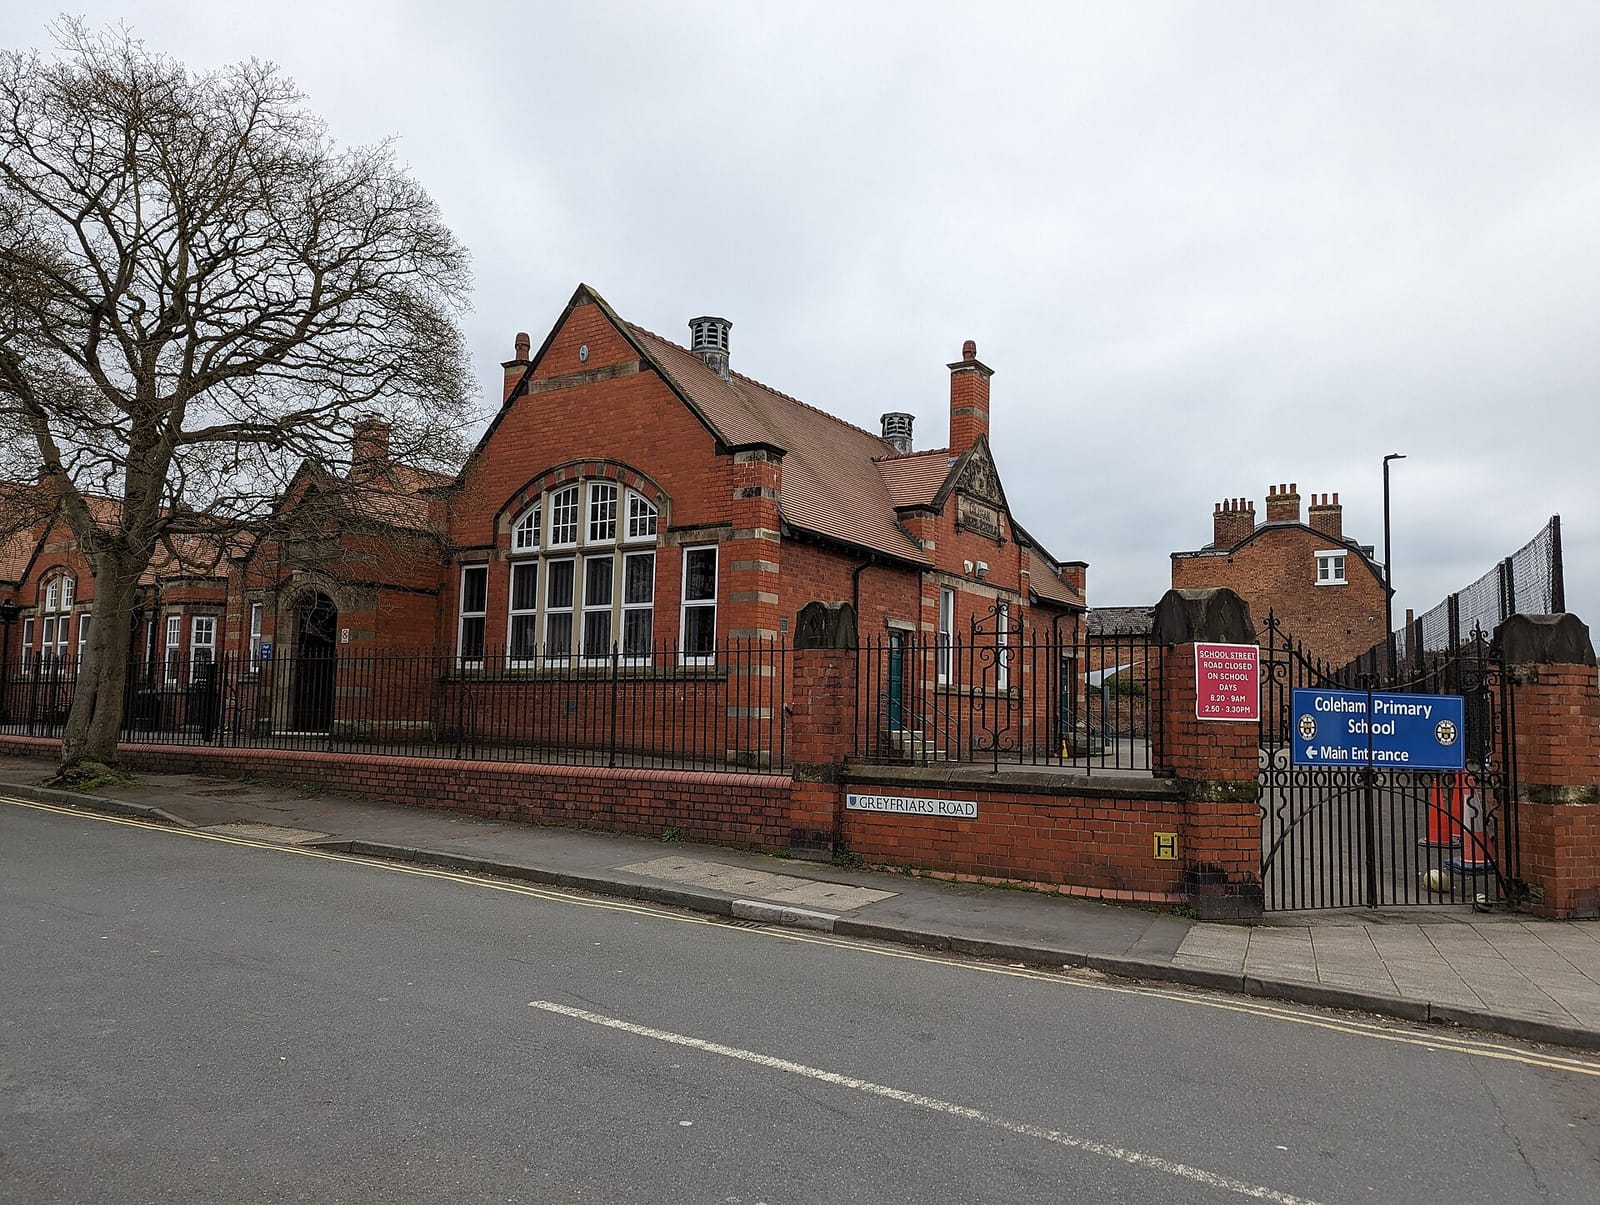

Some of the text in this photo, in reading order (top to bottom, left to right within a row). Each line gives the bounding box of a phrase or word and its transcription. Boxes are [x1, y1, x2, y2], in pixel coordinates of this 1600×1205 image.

[1199, 650, 1256, 660] SCHOOL STREET
[1203, 661, 1252, 670] ROAD CLOSED
[1210, 694, 1225, 702] 8.20
[1205, 705, 1220, 713] 2.50
[1314, 696, 1432, 719] Coleham Primary
[1348, 719, 1395, 735] School
[1320, 746, 1409, 762] Main Entrance
[859, 796, 975, 816] GREYFRIARS ROAD
[1157, 835, 1175, 858] H
